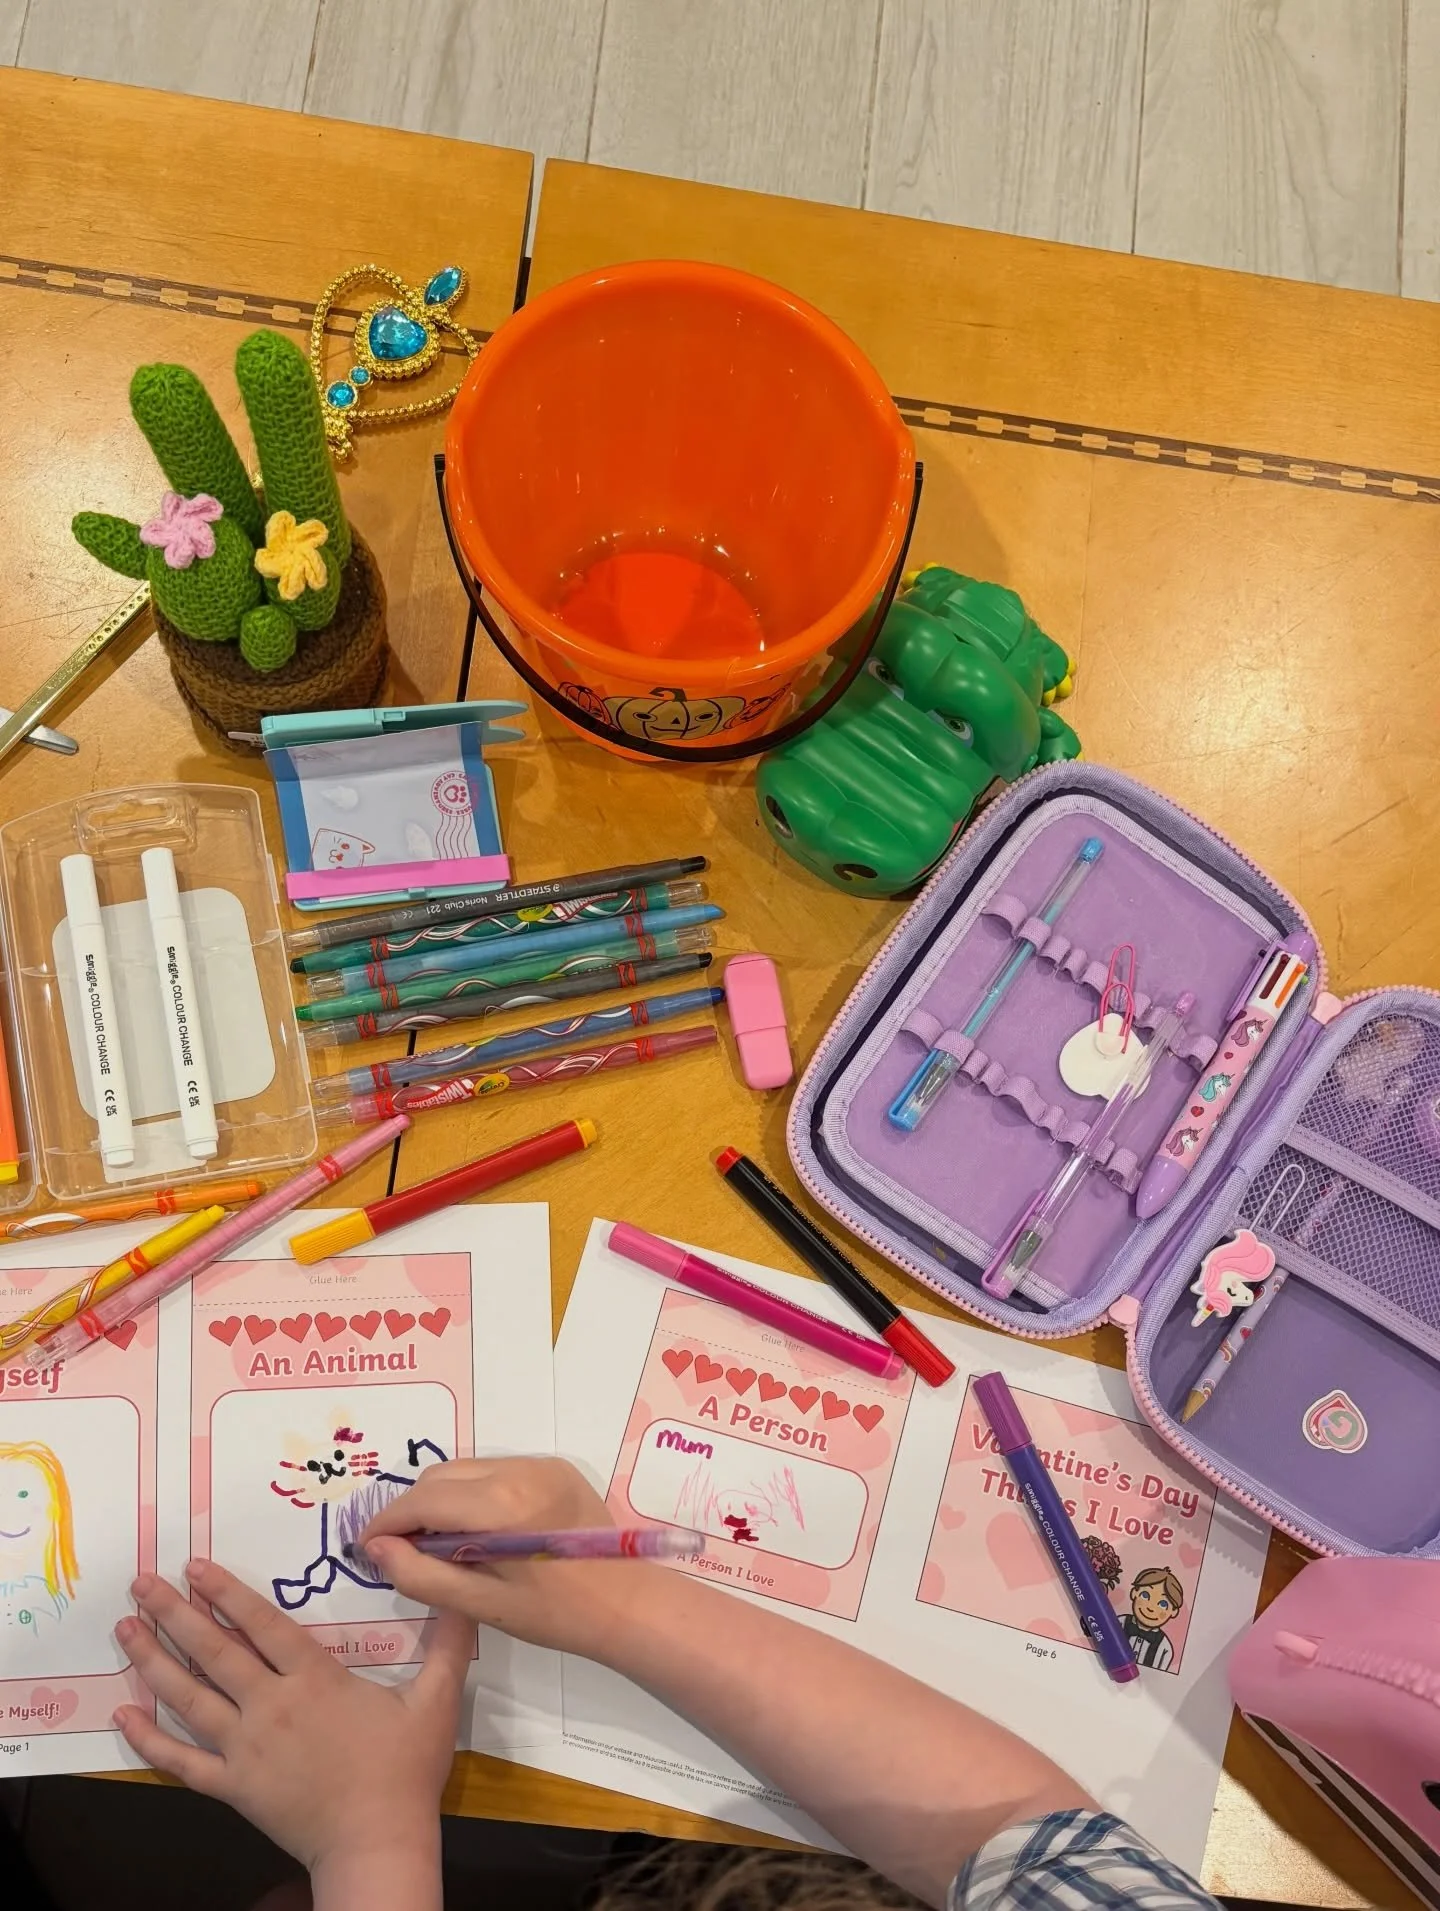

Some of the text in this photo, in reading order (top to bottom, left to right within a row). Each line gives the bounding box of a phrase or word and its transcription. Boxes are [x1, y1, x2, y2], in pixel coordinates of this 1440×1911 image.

[425, 904, 441, 913] 221
[444, 900, 464, 910] Club
[464, 896, 487, 906] Noris
[495, 885, 551, 901] STAEDTLER
[90, 993, 104, 1032] COLOUR
[172, 984, 186, 1024] COLOUR
[95, 1034, 110, 1074] CHANGE
[178, 1025, 192, 1066] CHANGE
[404, 1078, 472, 1110] Twistables
[310, 1275, 357, 1285] Glue Here
[761, 1334, 805, 1352] Glue Here
[249, 1344, 418, 1377] An Animal
[698, 1396, 827, 1451] A Person
[1141, 1475, 1199, 1518] Day
[1086, 1499, 1100, 1525] I
[1108, 1506, 1174, 1545] Love
[691, 1553, 732, 1575] Person
[736, 1567, 743, 1577] I
[746, 1570, 775, 1587] Love
[1042, 1521, 1065, 1560] COLOUR
[1061, 1561, 1084, 1602] CHANGE
[355, 1642, 360, 1652] I
[365, 1641, 395, 1652] Love
[1026, 1643, 1048, 1657] Page
[9, 1703, 59, 1720] Myself!
